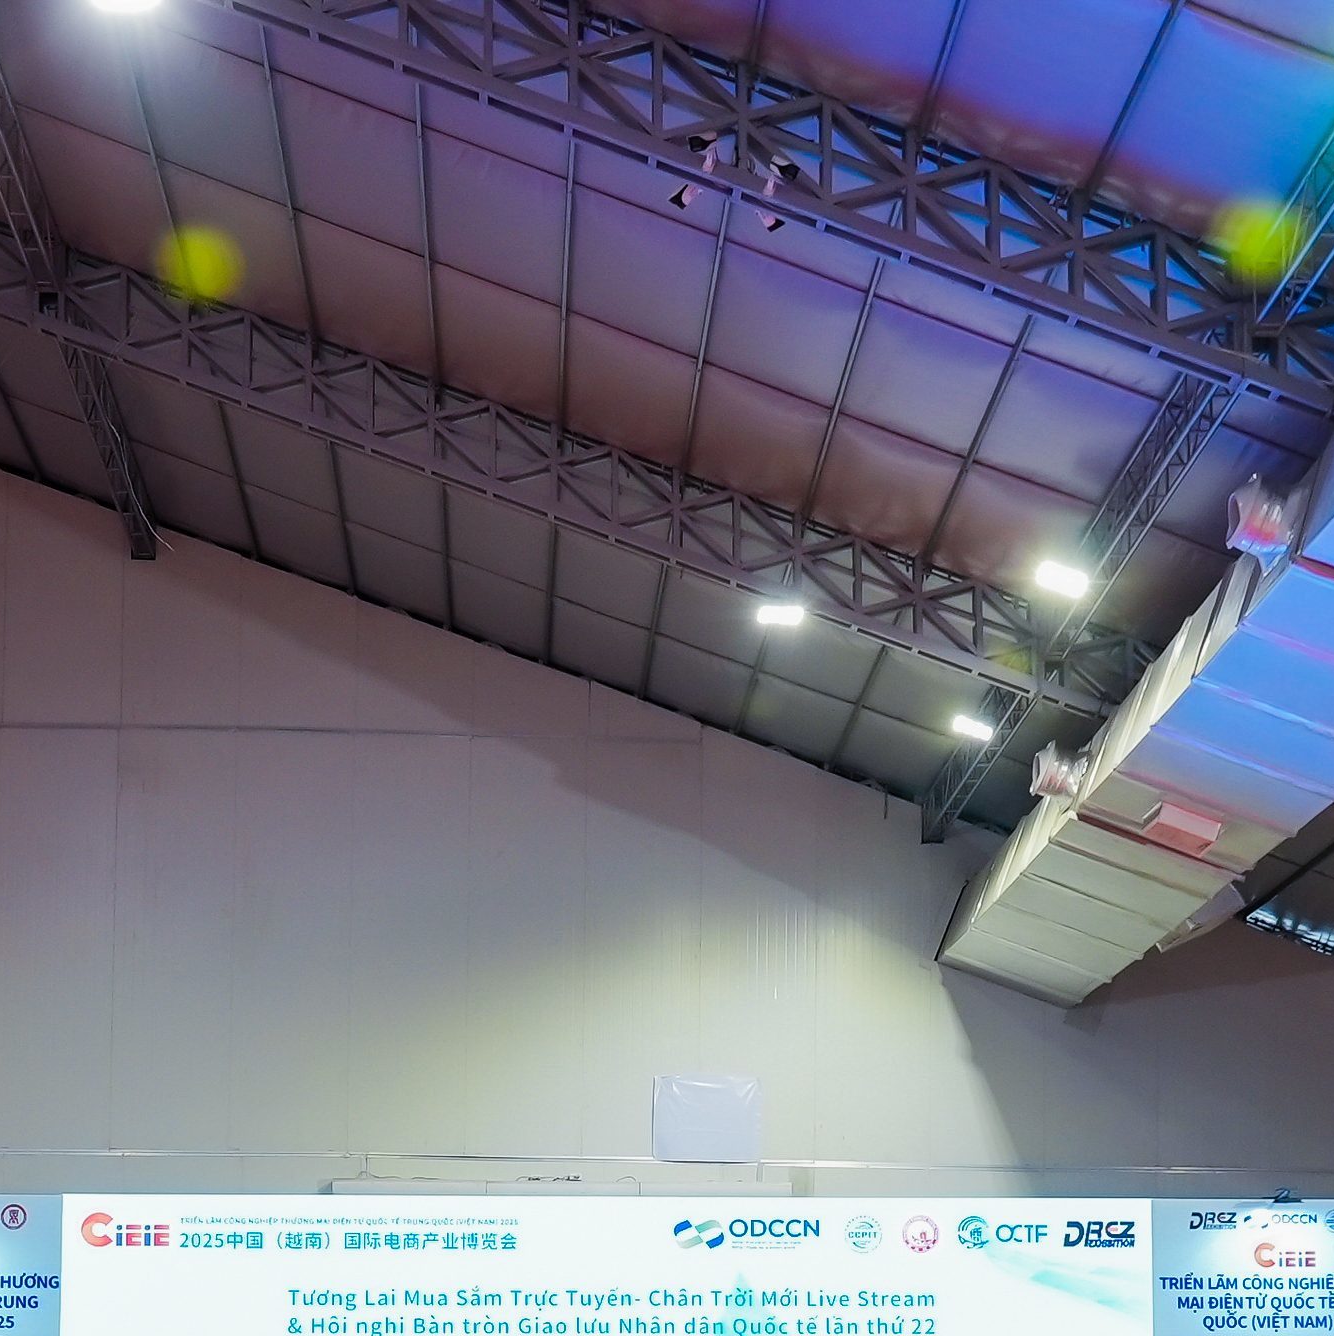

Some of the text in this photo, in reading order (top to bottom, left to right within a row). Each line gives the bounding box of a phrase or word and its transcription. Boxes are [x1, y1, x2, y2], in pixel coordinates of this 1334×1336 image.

[729, 1218, 820, 1238] ODCCN
[1272, 1214, 1317, 1224] ODCCN
[996, 1224, 1048, 1243] OCTF
[1242, 1274, 1284, 1290] CÔNG
[288, 1289, 357, 1310] Tương
[364, 1289, 395, 1306] Lai
[404, 1290, 448, 1306] Mua
[456, 1285, 502, 1306] Sắm
[510, 1289, 558, 1311] Trực
[649, 1288, 702, 1307] Chân
[710, 1288, 753, 1307] Trời
[762, 1288, 801, 1307] Mới
[807, 1289, 850, 1307] Live
[857, 1290, 935, 1307] Stream
[1177, 1296, 1204, 1313] MẠI
[287, 1317, 302, 1334] &
[414, 1316, 454, 1334] Bàn
[463, 1316, 509, 1334] tròn
[518, 1317, 567, 1334] Giao
[575, 1317, 610, 1334] lưu
[619, 1316, 675, 1334] Nhân
[684, 1316, 725, 1334] dân
[797, 1314, 818, 1334] tế
[867, 1315, 905, 1334] thứ
[911, 1318, 936, 1334] 22
[1252, 1312, 1290, 1332] (VIỆT
[1294, 1314, 1333, 1331] NAM)
